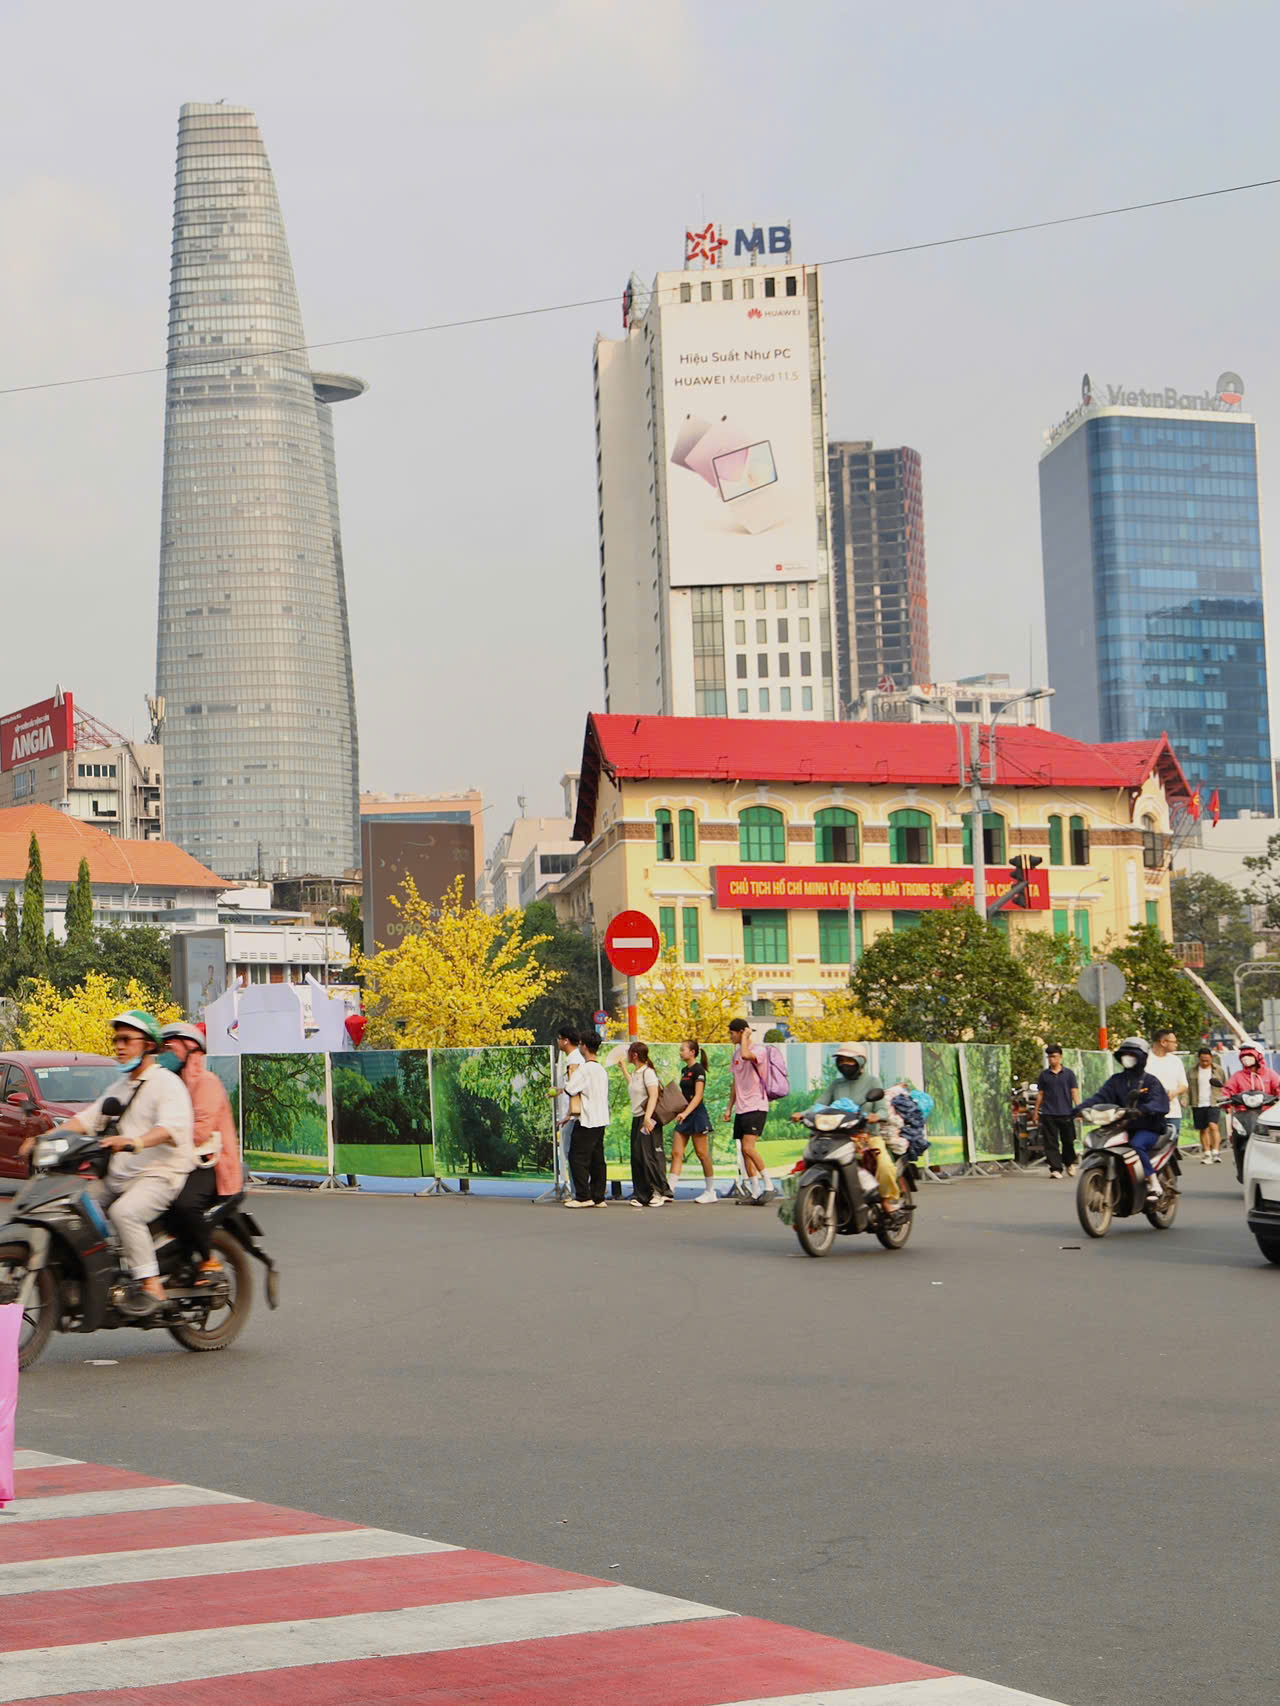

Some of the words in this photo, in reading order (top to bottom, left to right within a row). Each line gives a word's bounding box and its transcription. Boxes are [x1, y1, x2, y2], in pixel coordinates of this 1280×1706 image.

[734, 226, 792, 256] MB
[679, 353, 709, 365] Hiệu
[712, 348, 740, 362] Suất
[744, 349, 771, 361] Như
[774, 348, 792, 359] PC
[674, 375, 726, 387] HUAWEI
[730, 371, 775, 384] MatePad
[1106, 383, 1218, 412] VietinBank
[729, 877, 749, 895] CHỦ
[750, 881, 772, 898] TỊCH
[787, 879, 804, 896] CHÍ
[804, 881, 828, 896] MINH
[857, 878, 881, 897] SỐNG
[901, 883, 931, 897] TRONG
